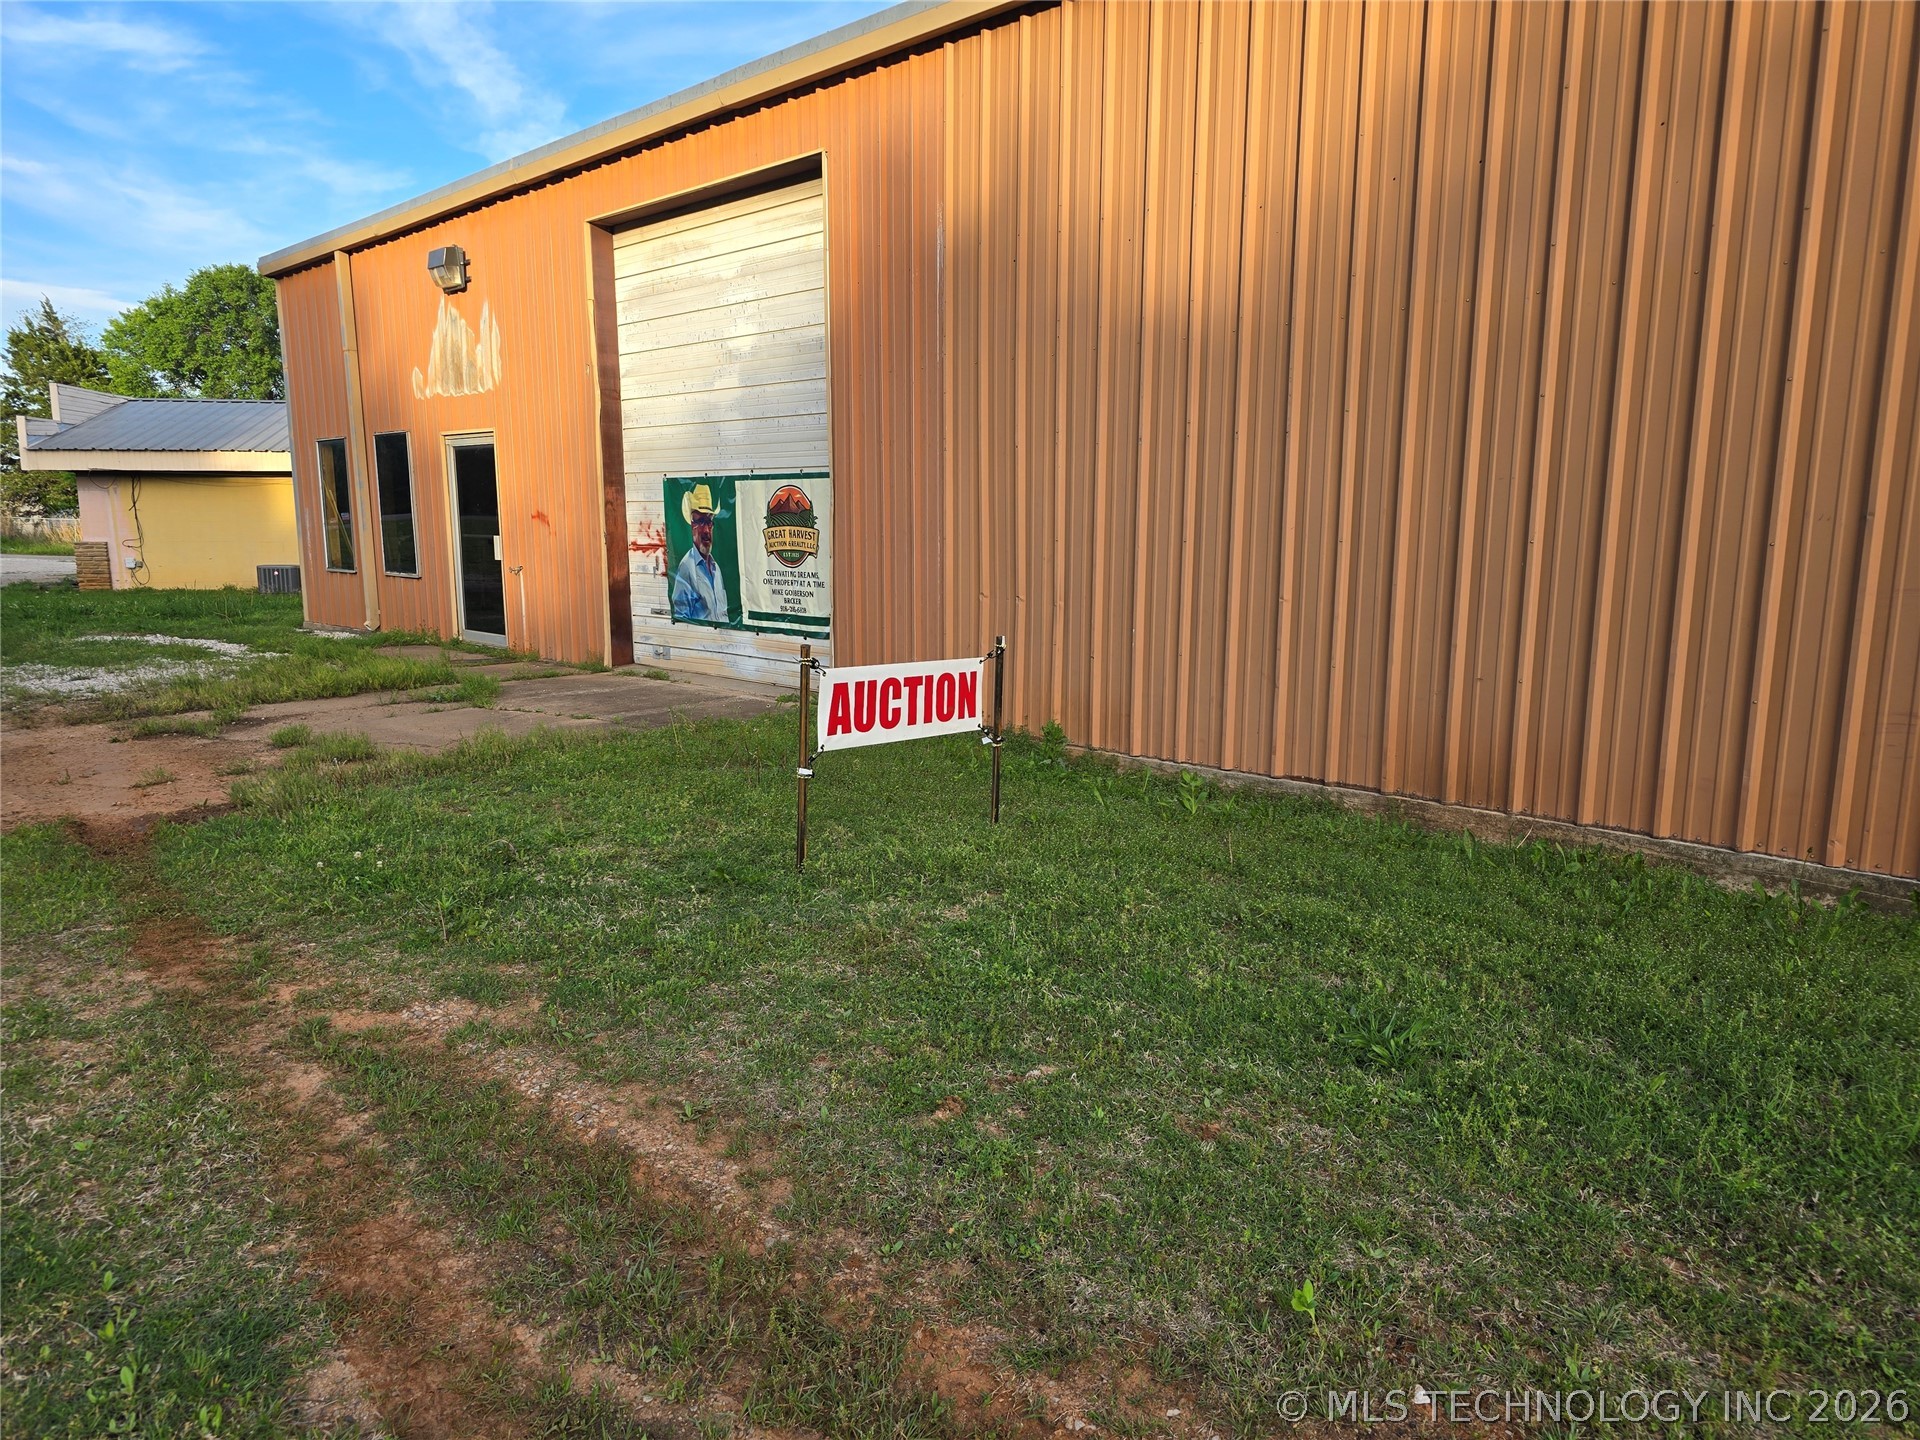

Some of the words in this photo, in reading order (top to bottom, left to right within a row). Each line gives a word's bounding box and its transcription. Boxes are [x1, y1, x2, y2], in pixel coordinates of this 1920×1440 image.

[767, 529, 787, 541] GREAT
[788, 529, 816, 541] HARVEST
[769, 541, 787, 549] AUCTION
[766, 570, 797, 578] CULTIVATING
[797, 571, 820, 579] DREAMS,
[774, 579, 799, 587] PROPERTY
[783, 597, 801, 605] BROKER
[827, 671, 977, 737] AUCTION
